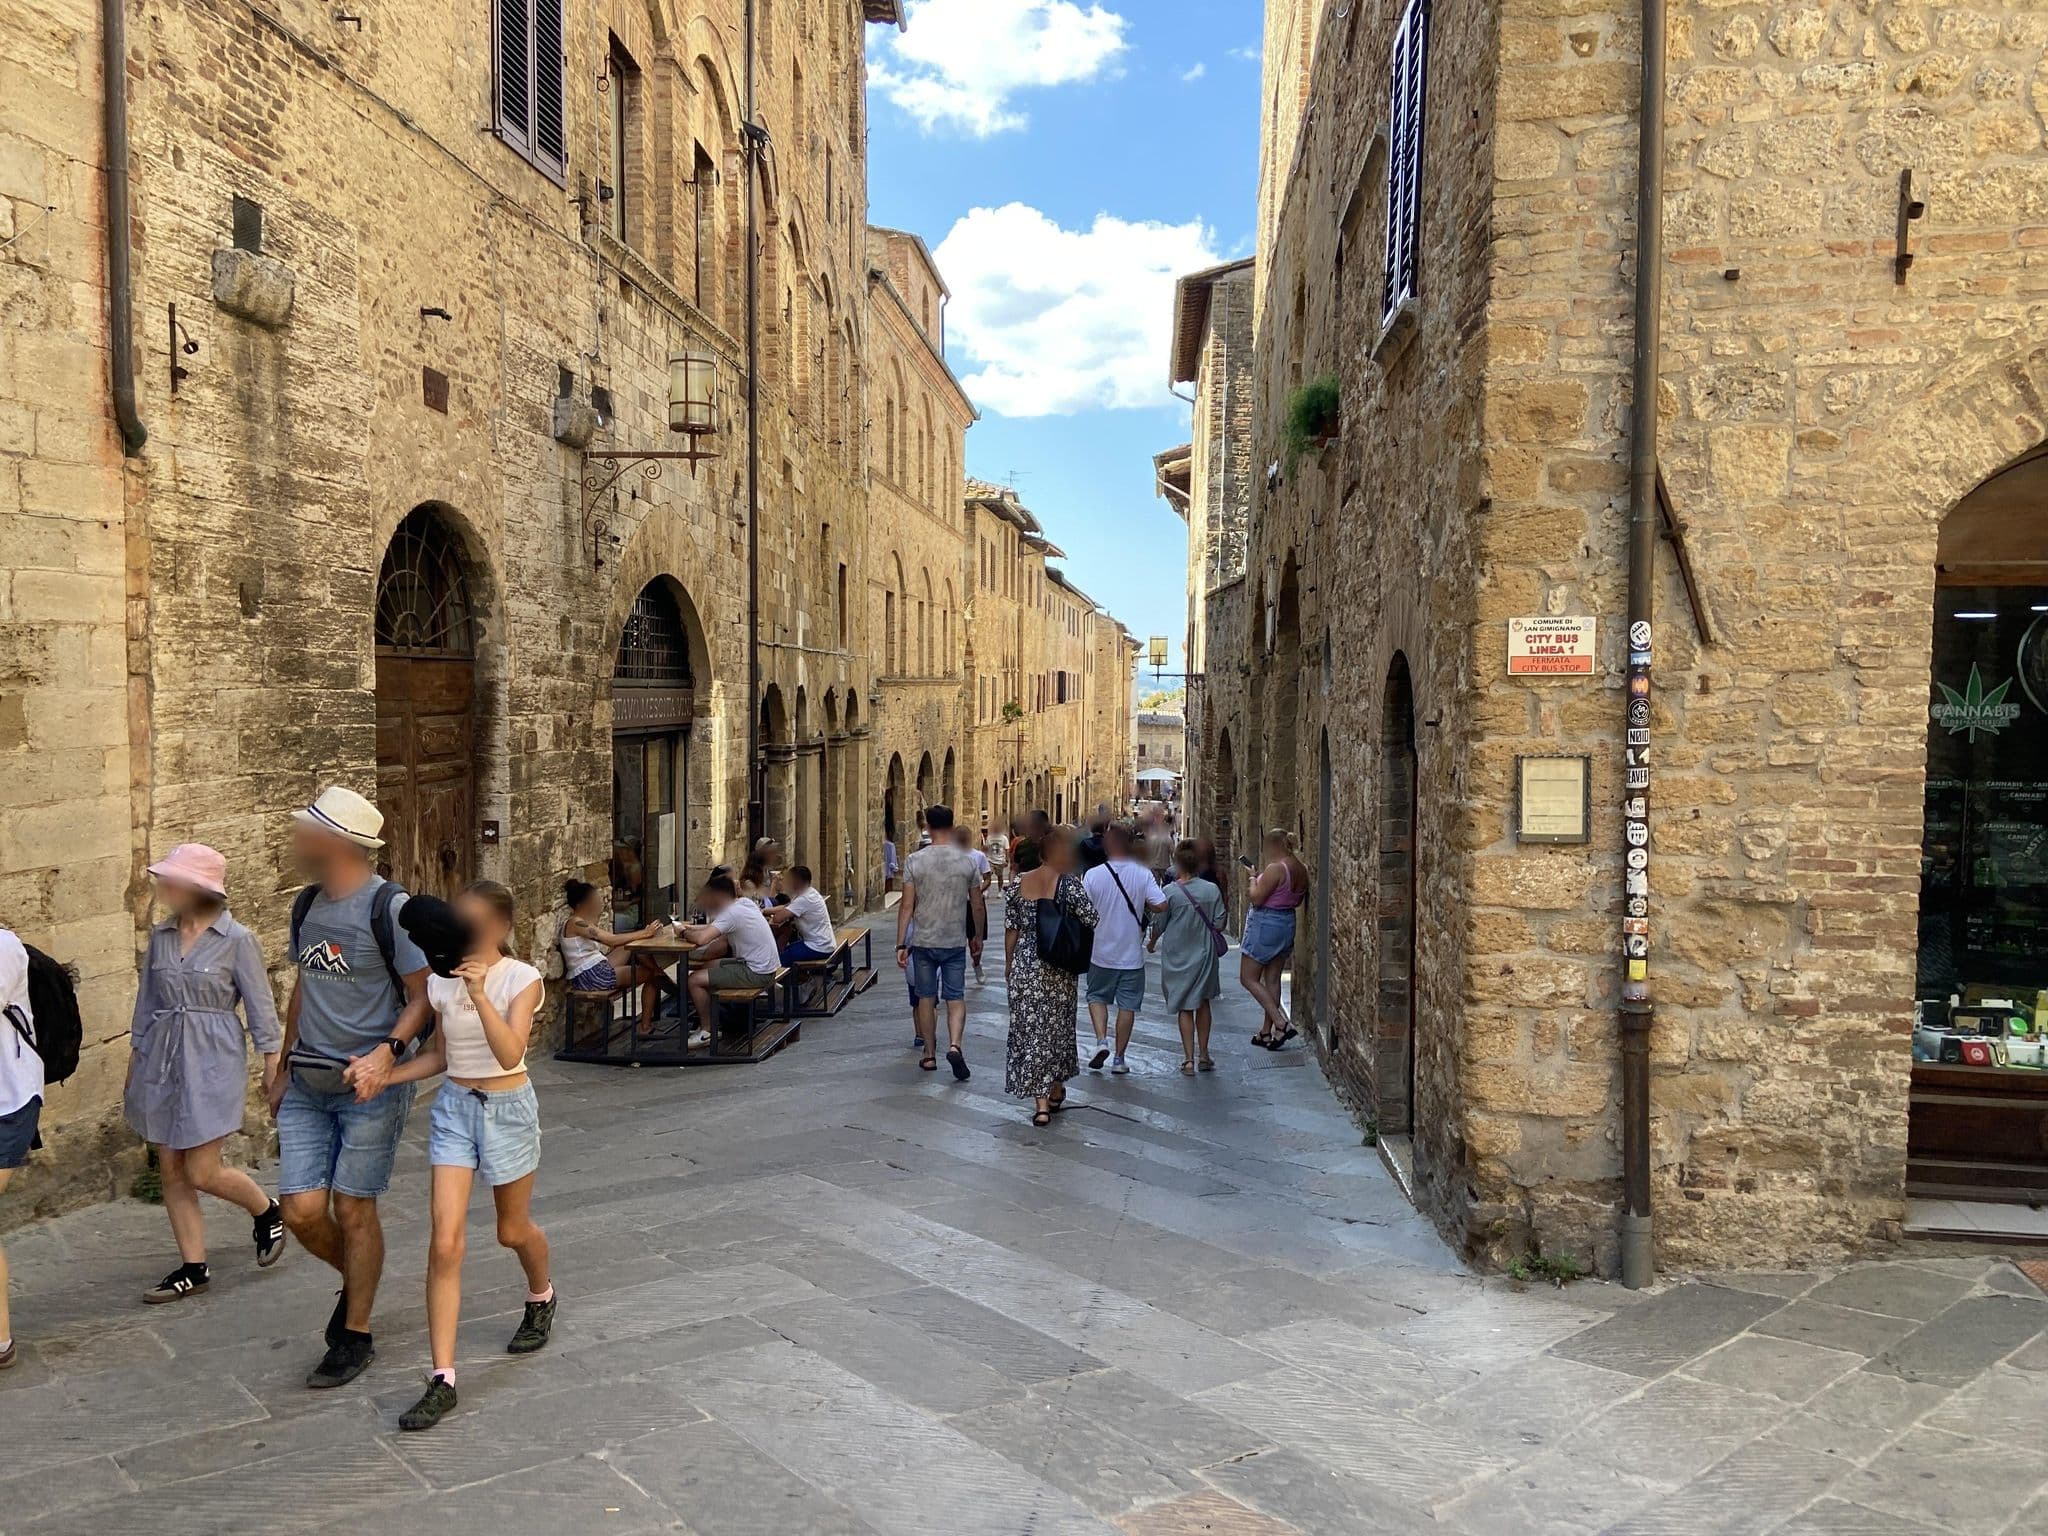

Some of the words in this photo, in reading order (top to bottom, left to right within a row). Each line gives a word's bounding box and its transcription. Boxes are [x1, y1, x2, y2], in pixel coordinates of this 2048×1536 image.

[1525, 634, 1552, 644] CITY
[1555, 634, 1579, 644] BUS
[1529, 645, 1565, 655] LINEA
[1568, 645, 1575, 654] 1
[1560, 664, 1581, 672] STOP
[1932, 704, 2019, 718] CANNABIS
